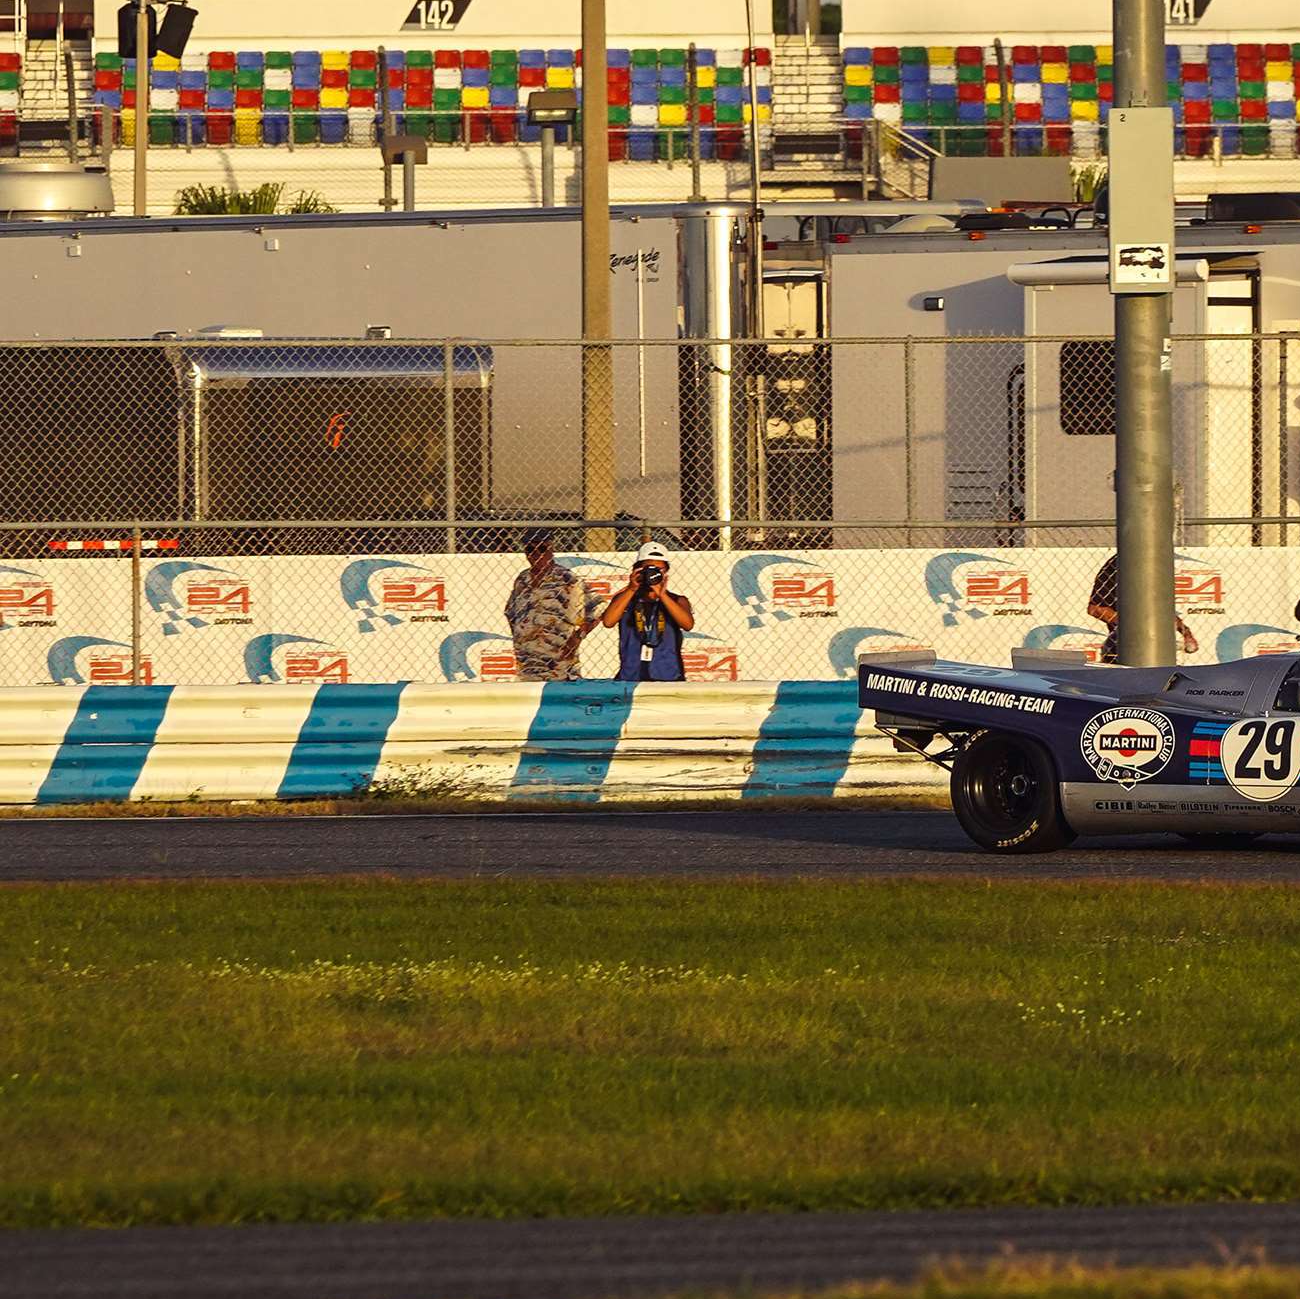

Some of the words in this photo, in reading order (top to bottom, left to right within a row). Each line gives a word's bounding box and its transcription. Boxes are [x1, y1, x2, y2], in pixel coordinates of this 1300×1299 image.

[417, 0, 455, 30] 142
[187, 587, 253, 613] 24
[383, 583, 448, 611] 24
[772, 579, 838, 606] 24
[967, 577, 1032, 604] 24
[89, 661, 156, 685] 24
[285, 658, 352, 684] 24
[682, 653, 741, 682] 24
[866, 673, 917, 695] MARTINI
[917, 681, 927, 696] &
[929, 682, 1056, 715] ROSSI-RACING-TEAM
[1083, 719, 1101, 764] MARTINI
[1102, 708, 1171, 734] INTERNATIONAL
[1158, 735, 1173, 764] CLUB
[1102, 737, 1155, 749] MARTINI
[1234, 720, 1296, 781] 29
[1181, 803, 1219, 811] BILSTEIN
[1267, 804, 1297, 813] BOSCH
